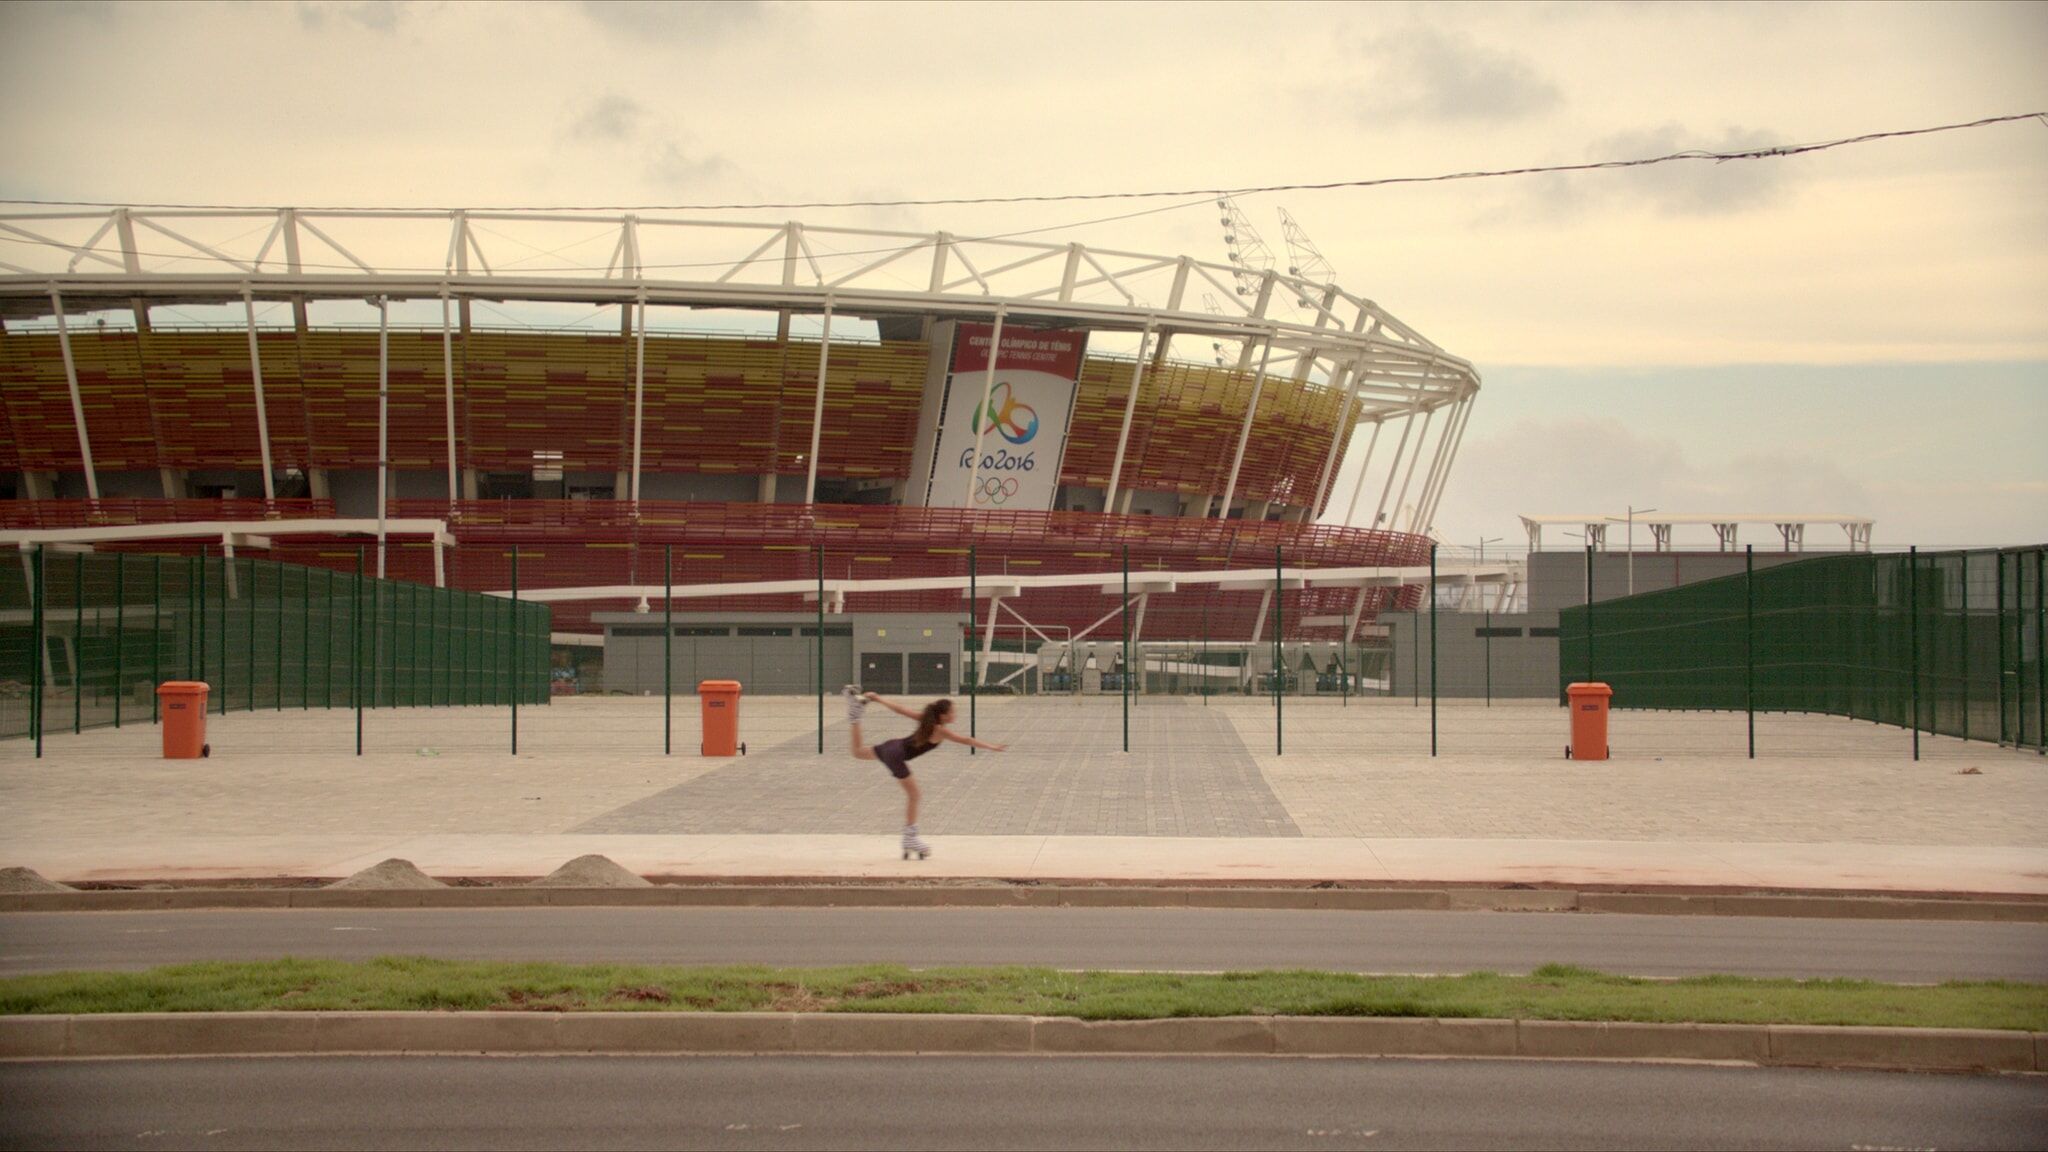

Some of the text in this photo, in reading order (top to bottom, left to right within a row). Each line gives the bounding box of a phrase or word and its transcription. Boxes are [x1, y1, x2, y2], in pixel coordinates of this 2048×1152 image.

[1001, 337, 1037, 350] OLÍMPICO
[1038, 340, 1049, 350] DE
[1050, 340, 1072, 352] TÊNIS
[1008, 350, 1032, 360] TENNIS
[1032, 352, 1057, 362] CENTRE
